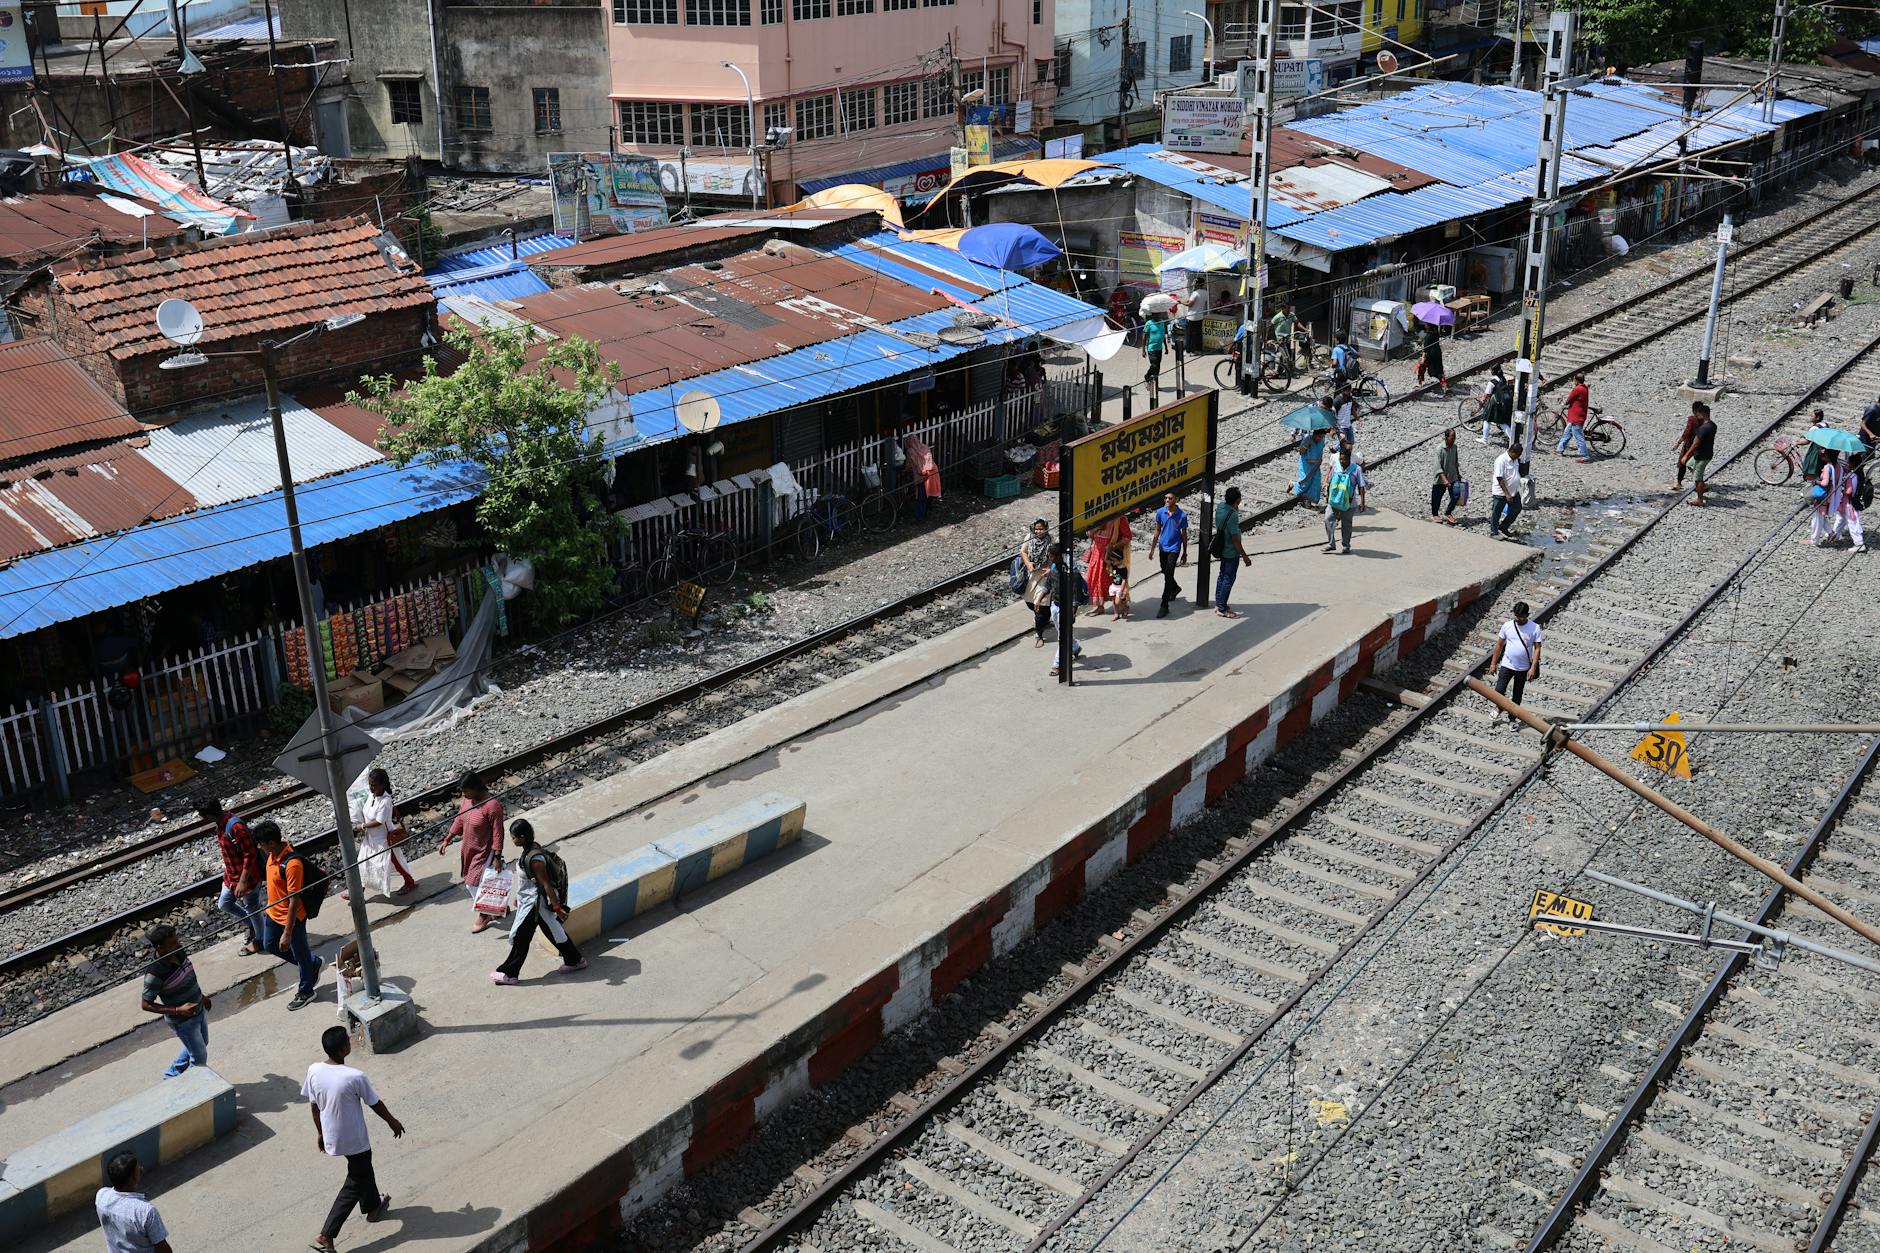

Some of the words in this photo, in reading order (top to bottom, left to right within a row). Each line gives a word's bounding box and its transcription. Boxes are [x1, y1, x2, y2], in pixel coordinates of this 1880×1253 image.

[1274, 62, 1304, 73] RUPATI
[1196, 101, 1220, 112] VINAYAK
[1220, 101, 1242, 112] MOBILES
[1100, 411, 1186, 463] মধ্যমগ্রাম
[1101, 436, 1185, 486] मध्यमग्राम
[1084, 458, 1189, 520] MADHYAMGRAM
[1646, 732, 1681, 769] 30
